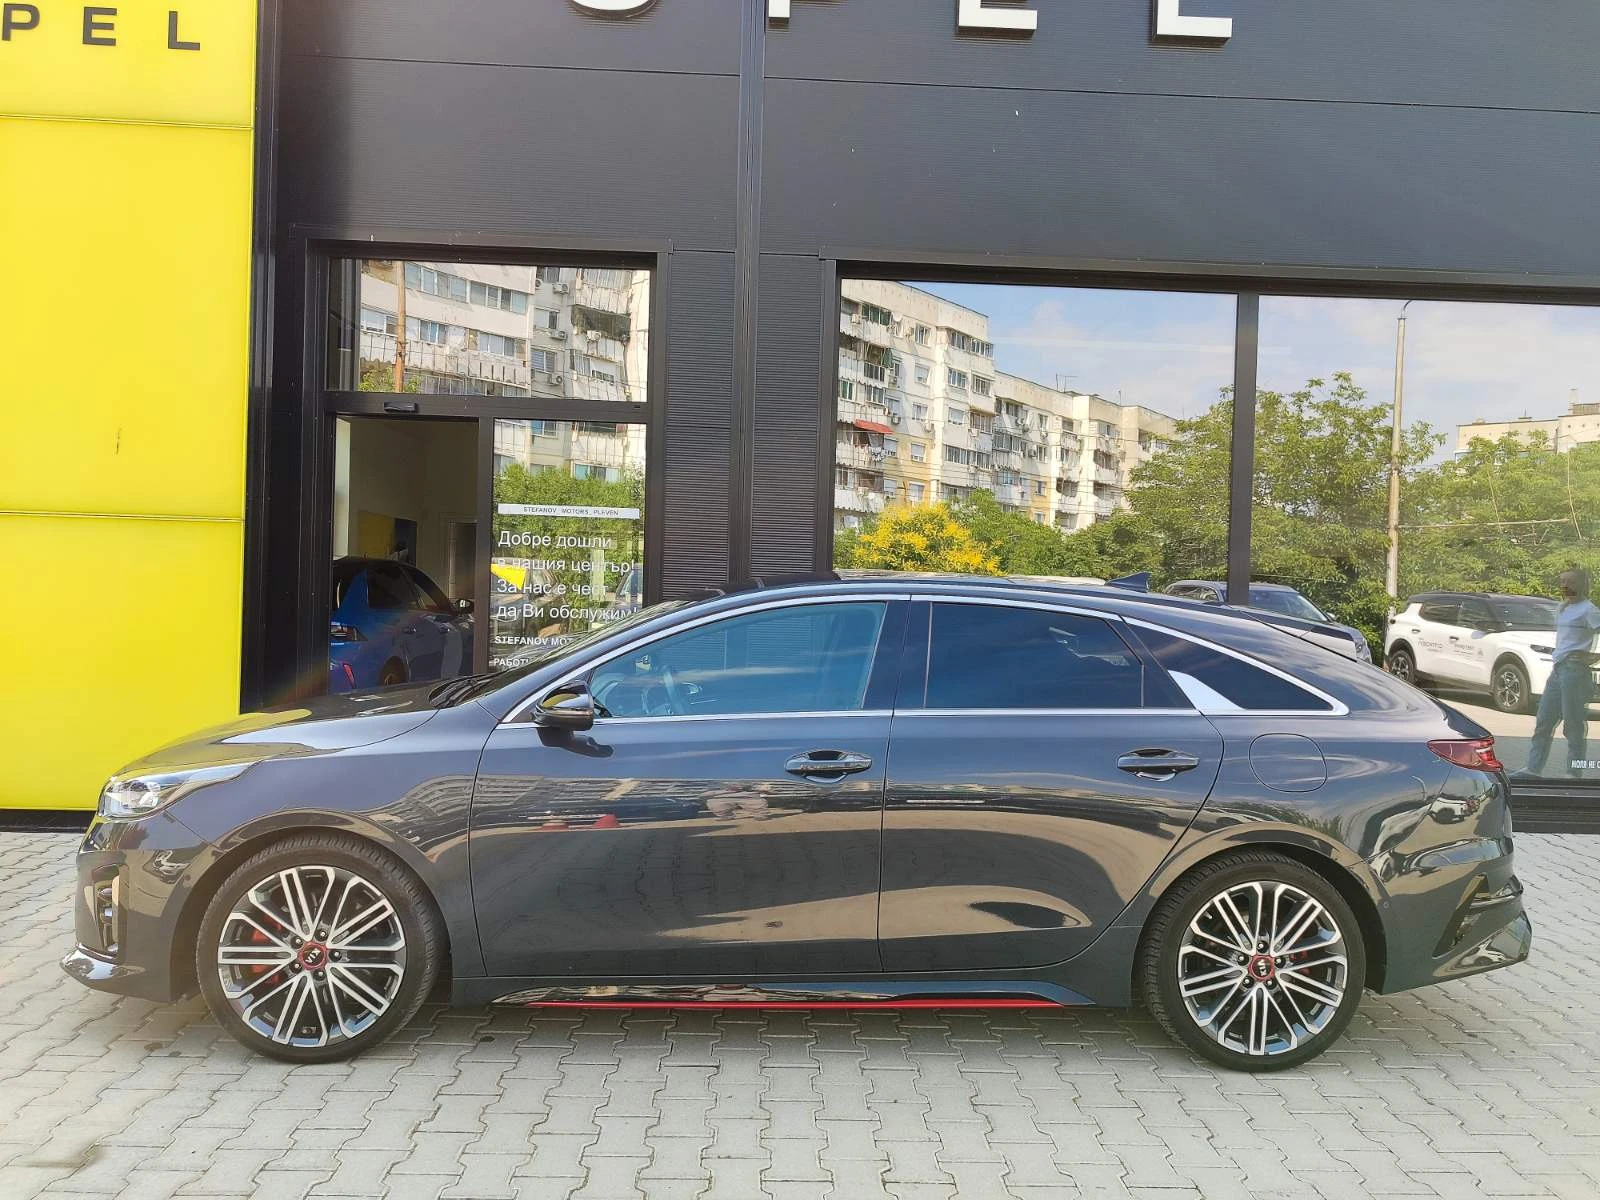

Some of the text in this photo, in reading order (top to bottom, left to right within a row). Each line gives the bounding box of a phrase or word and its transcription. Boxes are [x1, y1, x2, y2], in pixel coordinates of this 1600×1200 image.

[1, 2, 201, 51] PEL
[498, 530, 612, 549] Добре дошли
[512, 559, 566, 571] нашия
[497, 578, 518, 594] За
[522, 583, 552, 595] нас
[557, 584, 566, 595] е
[497, 605, 517, 620] да
[523, 603, 544, 618] Ви
[494, 635, 550, 646] STEFANOV
